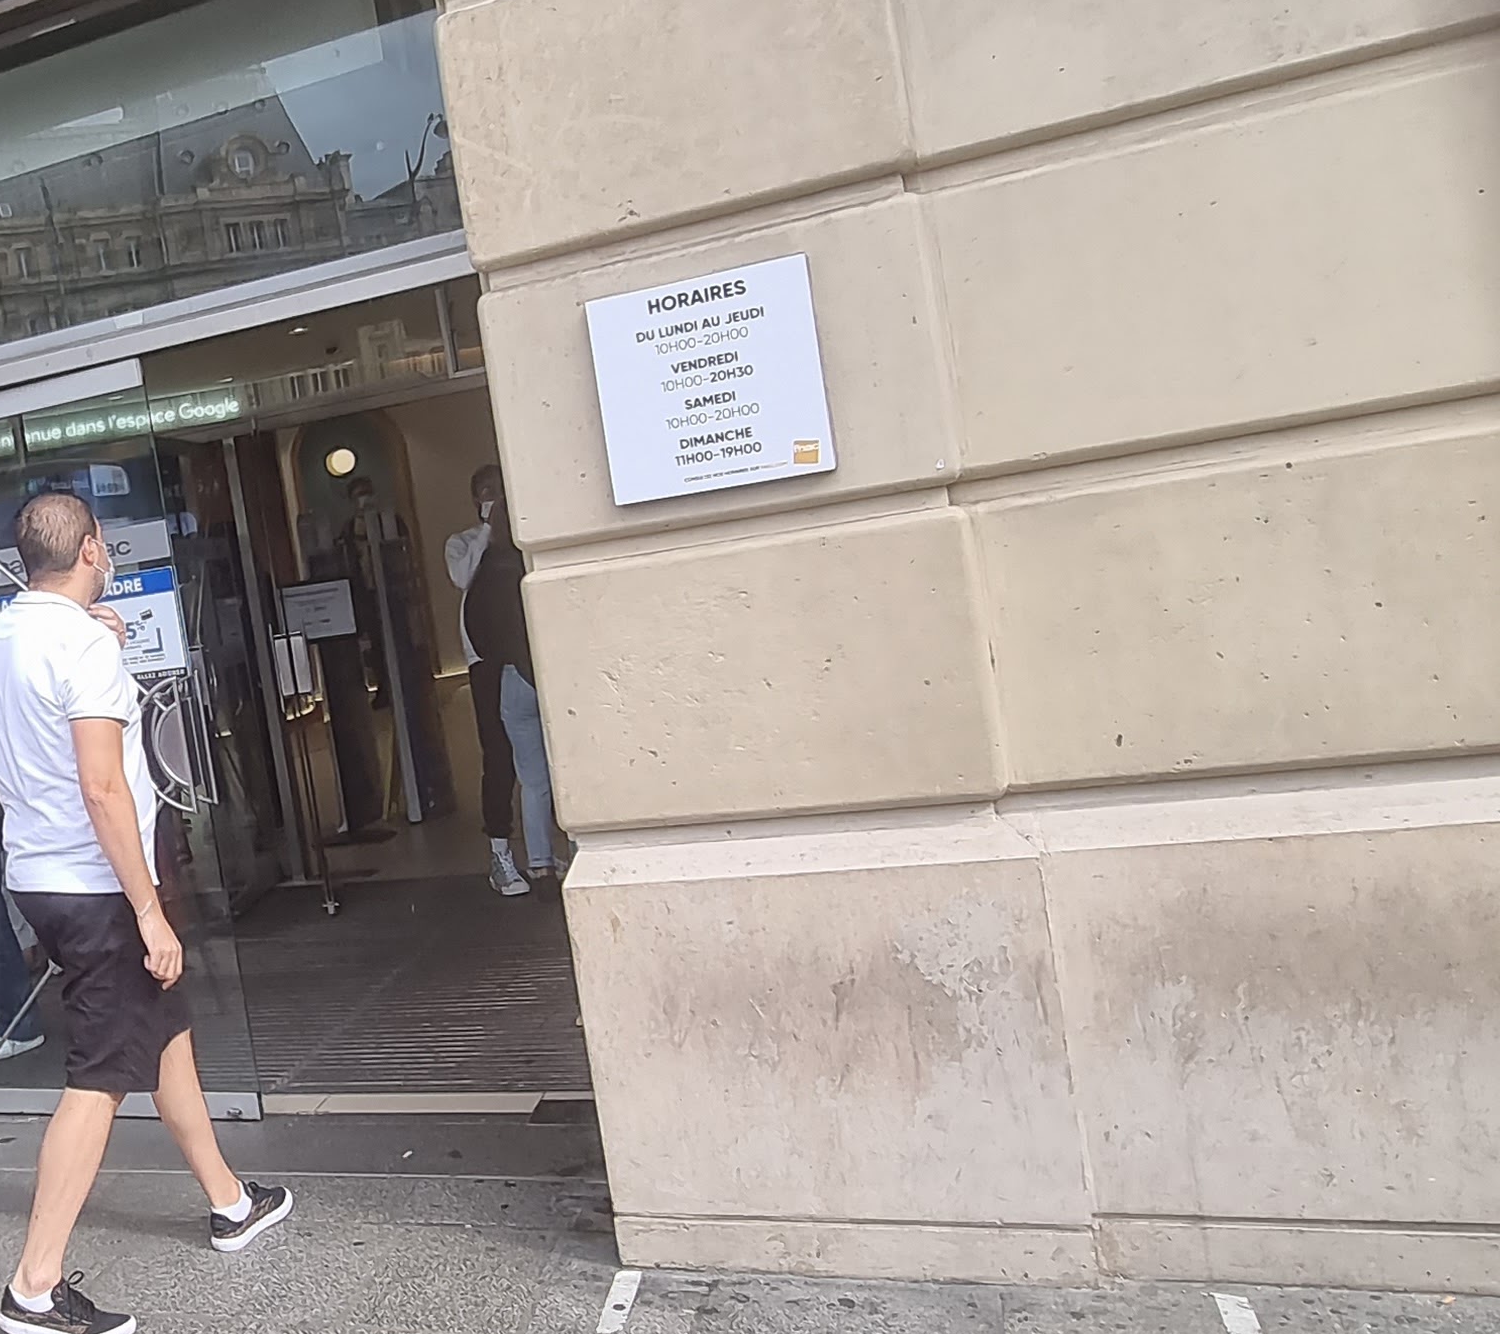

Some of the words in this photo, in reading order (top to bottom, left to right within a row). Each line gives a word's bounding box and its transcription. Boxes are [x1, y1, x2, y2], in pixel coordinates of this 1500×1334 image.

[647, 279, 747, 315] HORAIRES
[636, 329, 655, 343] DU
[658, 320, 698, 338] LUNDI
[701, 315, 721, 330] AU
[724, 306, 765, 325] JEUDI
[655, 326, 749, 355] 10H00-20H00
[670, 351, 739, 374] VENDREDI
[661, 364, 754, 393] 10H00-20H30
[684, 390, 737, 410] SAMEDI
[65, 419, 106, 438] dans
[178, 397, 240, 420] Google
[666, 402, 760, 430] 10H00-20H00
[679, 426, 753, 450] DIMANCHE
[675, 441, 763, 467] 11H00-19H00
